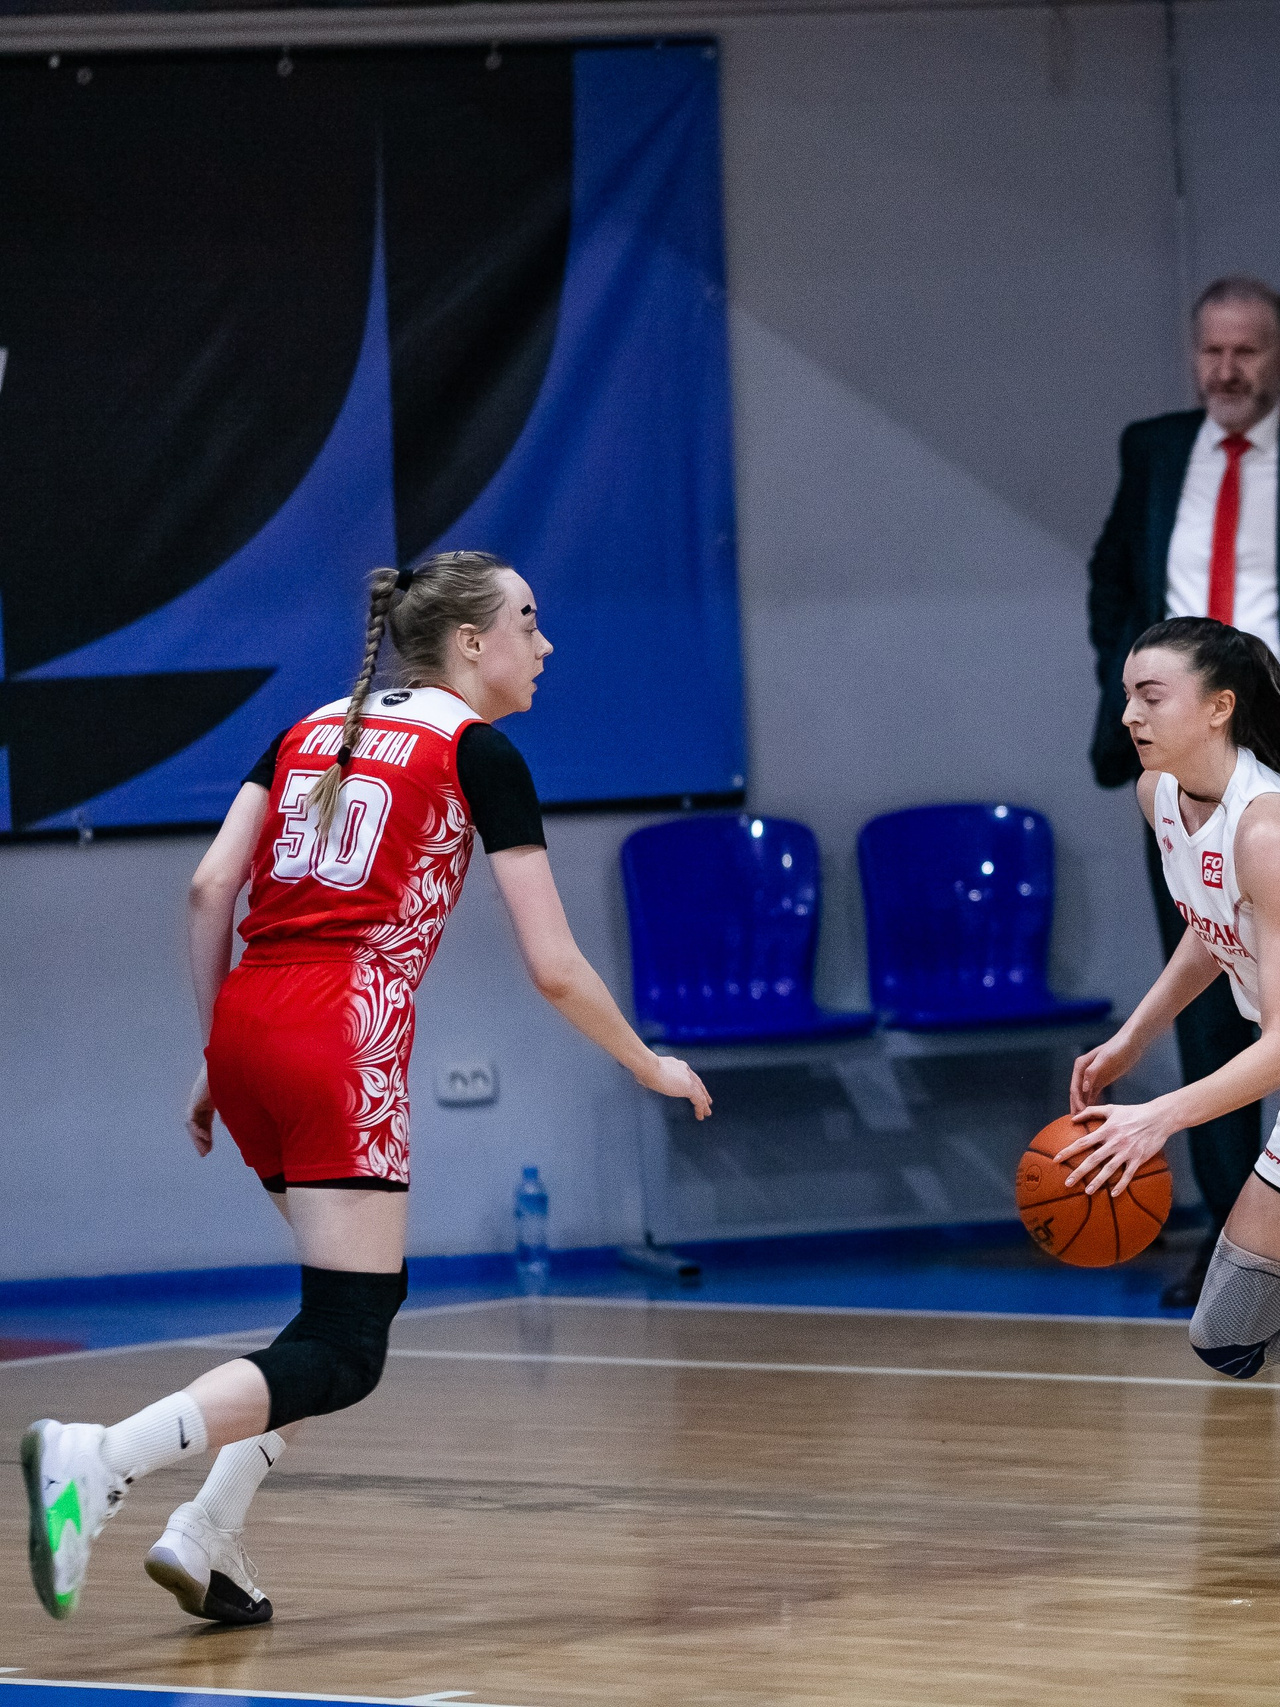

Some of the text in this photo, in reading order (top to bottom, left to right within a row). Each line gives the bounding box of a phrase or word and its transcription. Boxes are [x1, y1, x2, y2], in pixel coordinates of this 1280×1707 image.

[298, 724, 419, 767] КРИВШЕИНА
[270, 769, 392, 891] 30
[1203, 855, 1223, 870] FO
[1203, 868, 1222, 884] BE
